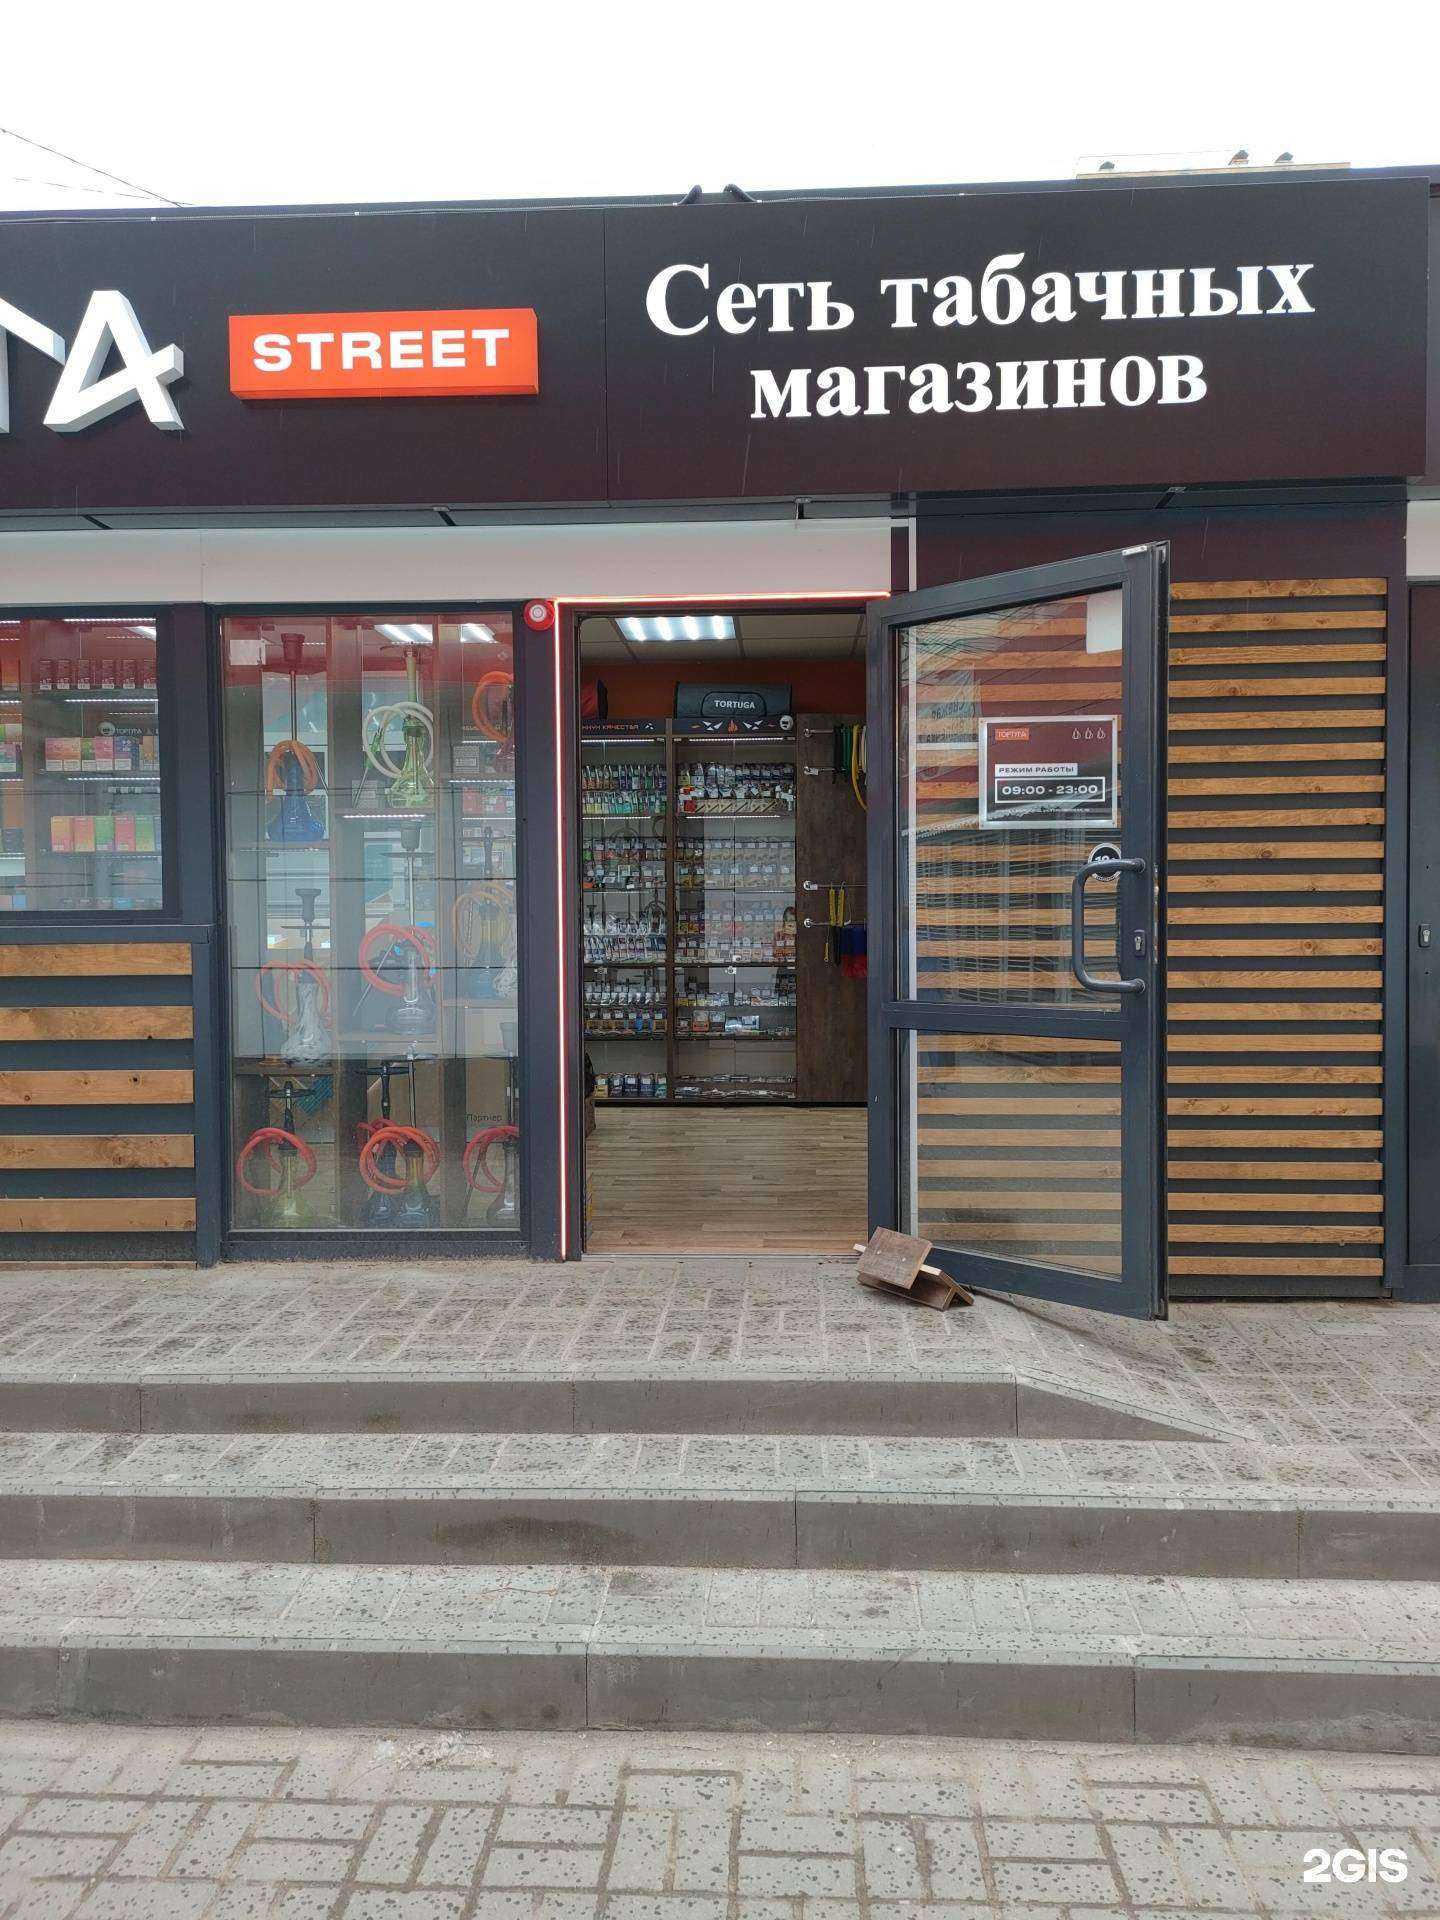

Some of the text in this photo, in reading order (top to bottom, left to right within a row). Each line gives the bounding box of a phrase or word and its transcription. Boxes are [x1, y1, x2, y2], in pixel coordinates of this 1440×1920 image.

[645, 252, 1316, 336] Сеть табачных
[252, 328, 510, 372] STREET
[750, 354, 1207, 419] магазинов
[714, 700, 756, 710] TORTUGA
[1002, 786, 1045, 795] 09:00
[1056, 785, 1098, 794] 23:00
